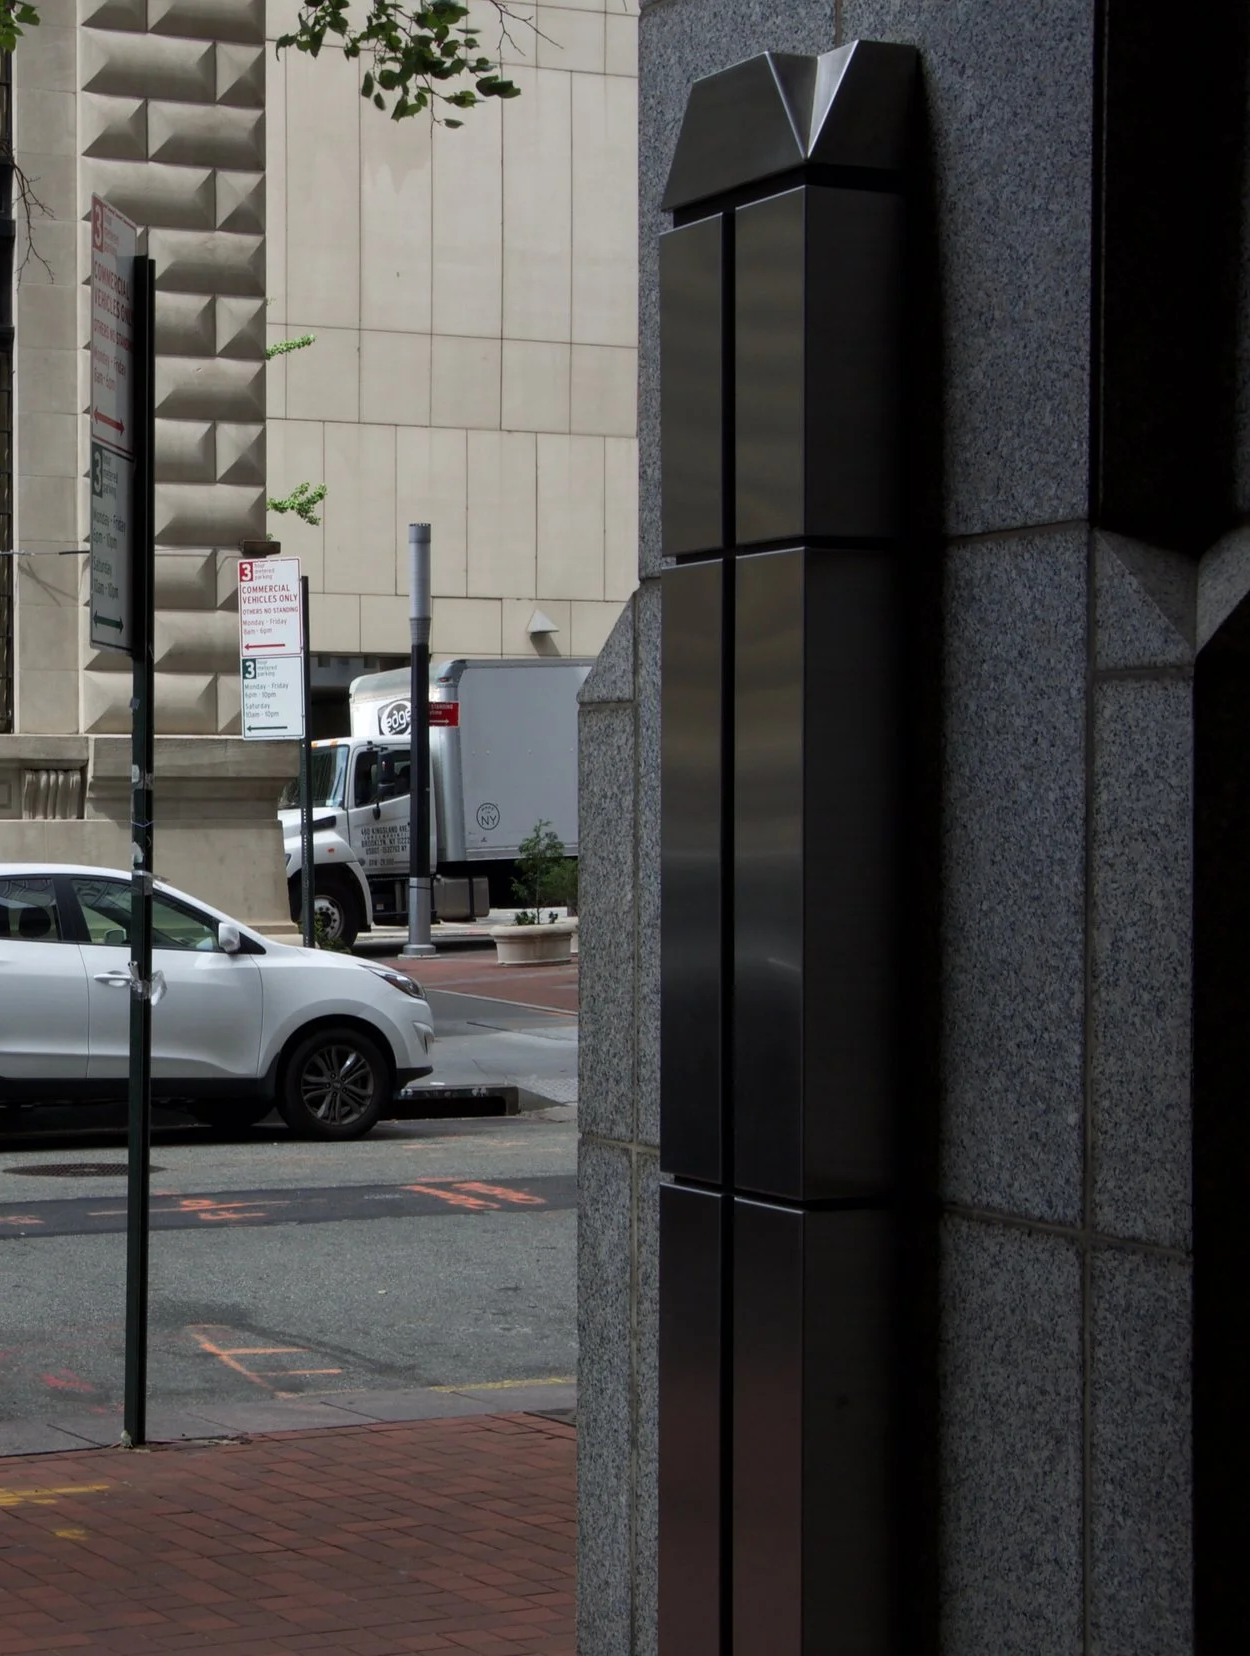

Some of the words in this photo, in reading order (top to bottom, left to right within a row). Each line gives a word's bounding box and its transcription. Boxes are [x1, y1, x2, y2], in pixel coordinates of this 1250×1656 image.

[94, 205, 102, 247] 3
[94, 260, 130, 301] COMMERCIAL
[94, 287, 120, 320] VEHICLES
[94, 451, 102, 493] 3
[113, 514, 126, 536] Friday
[94, 555, 112, 577] Saturday
[241, 563, 252, 581] 3
[242, 584, 290, 594] COMMERCIAL
[242, 595, 277, 604] VEHICLES
[279, 594, 298, 603] ONLY
[243, 608, 263, 616] OTHERS
[273, 606, 298, 614] STANDING
[243, 619, 264, 627] Monday
[269, 618, 287, 626] Friday
[260, 627, 272, 636] 6pm
[245, 661, 255, 679] 3
[245, 683, 266, 691] Monday
[271, 682, 289, 690] Friday
[262, 691, 276, 699] 10pm
[264, 710, 279, 718] 10pm
[386, 707, 411, 731] edge
[481, 815, 497, 826] NY
